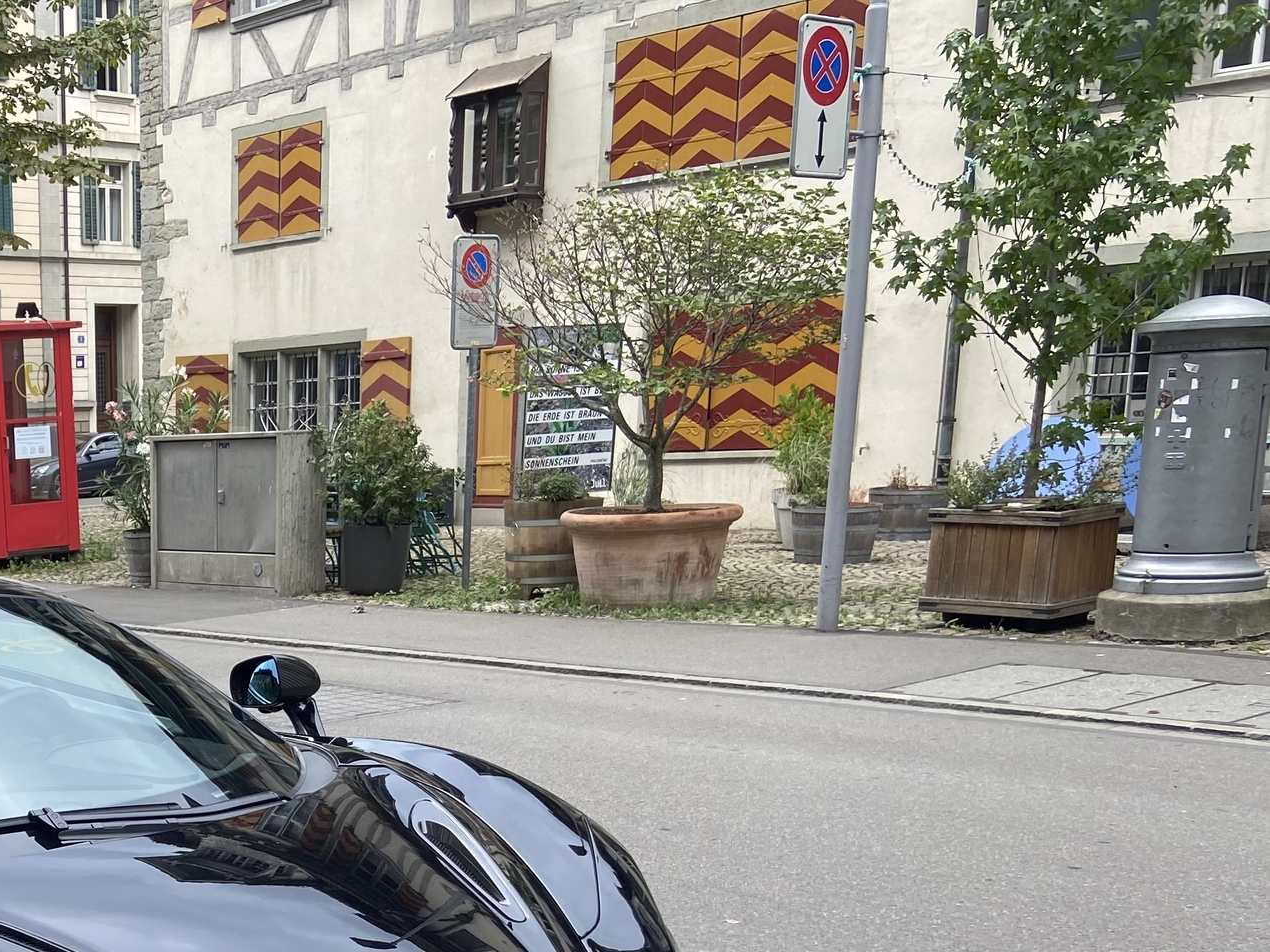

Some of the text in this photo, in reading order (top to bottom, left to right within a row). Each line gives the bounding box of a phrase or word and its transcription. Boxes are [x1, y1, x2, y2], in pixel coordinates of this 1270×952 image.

[528, 409, 602, 423] DIE ERDE IST BRAUN
[527, 432, 597, 446] UND DU BIST MEIN
[526, 456, 580, 469] SONNENSCHEIN
